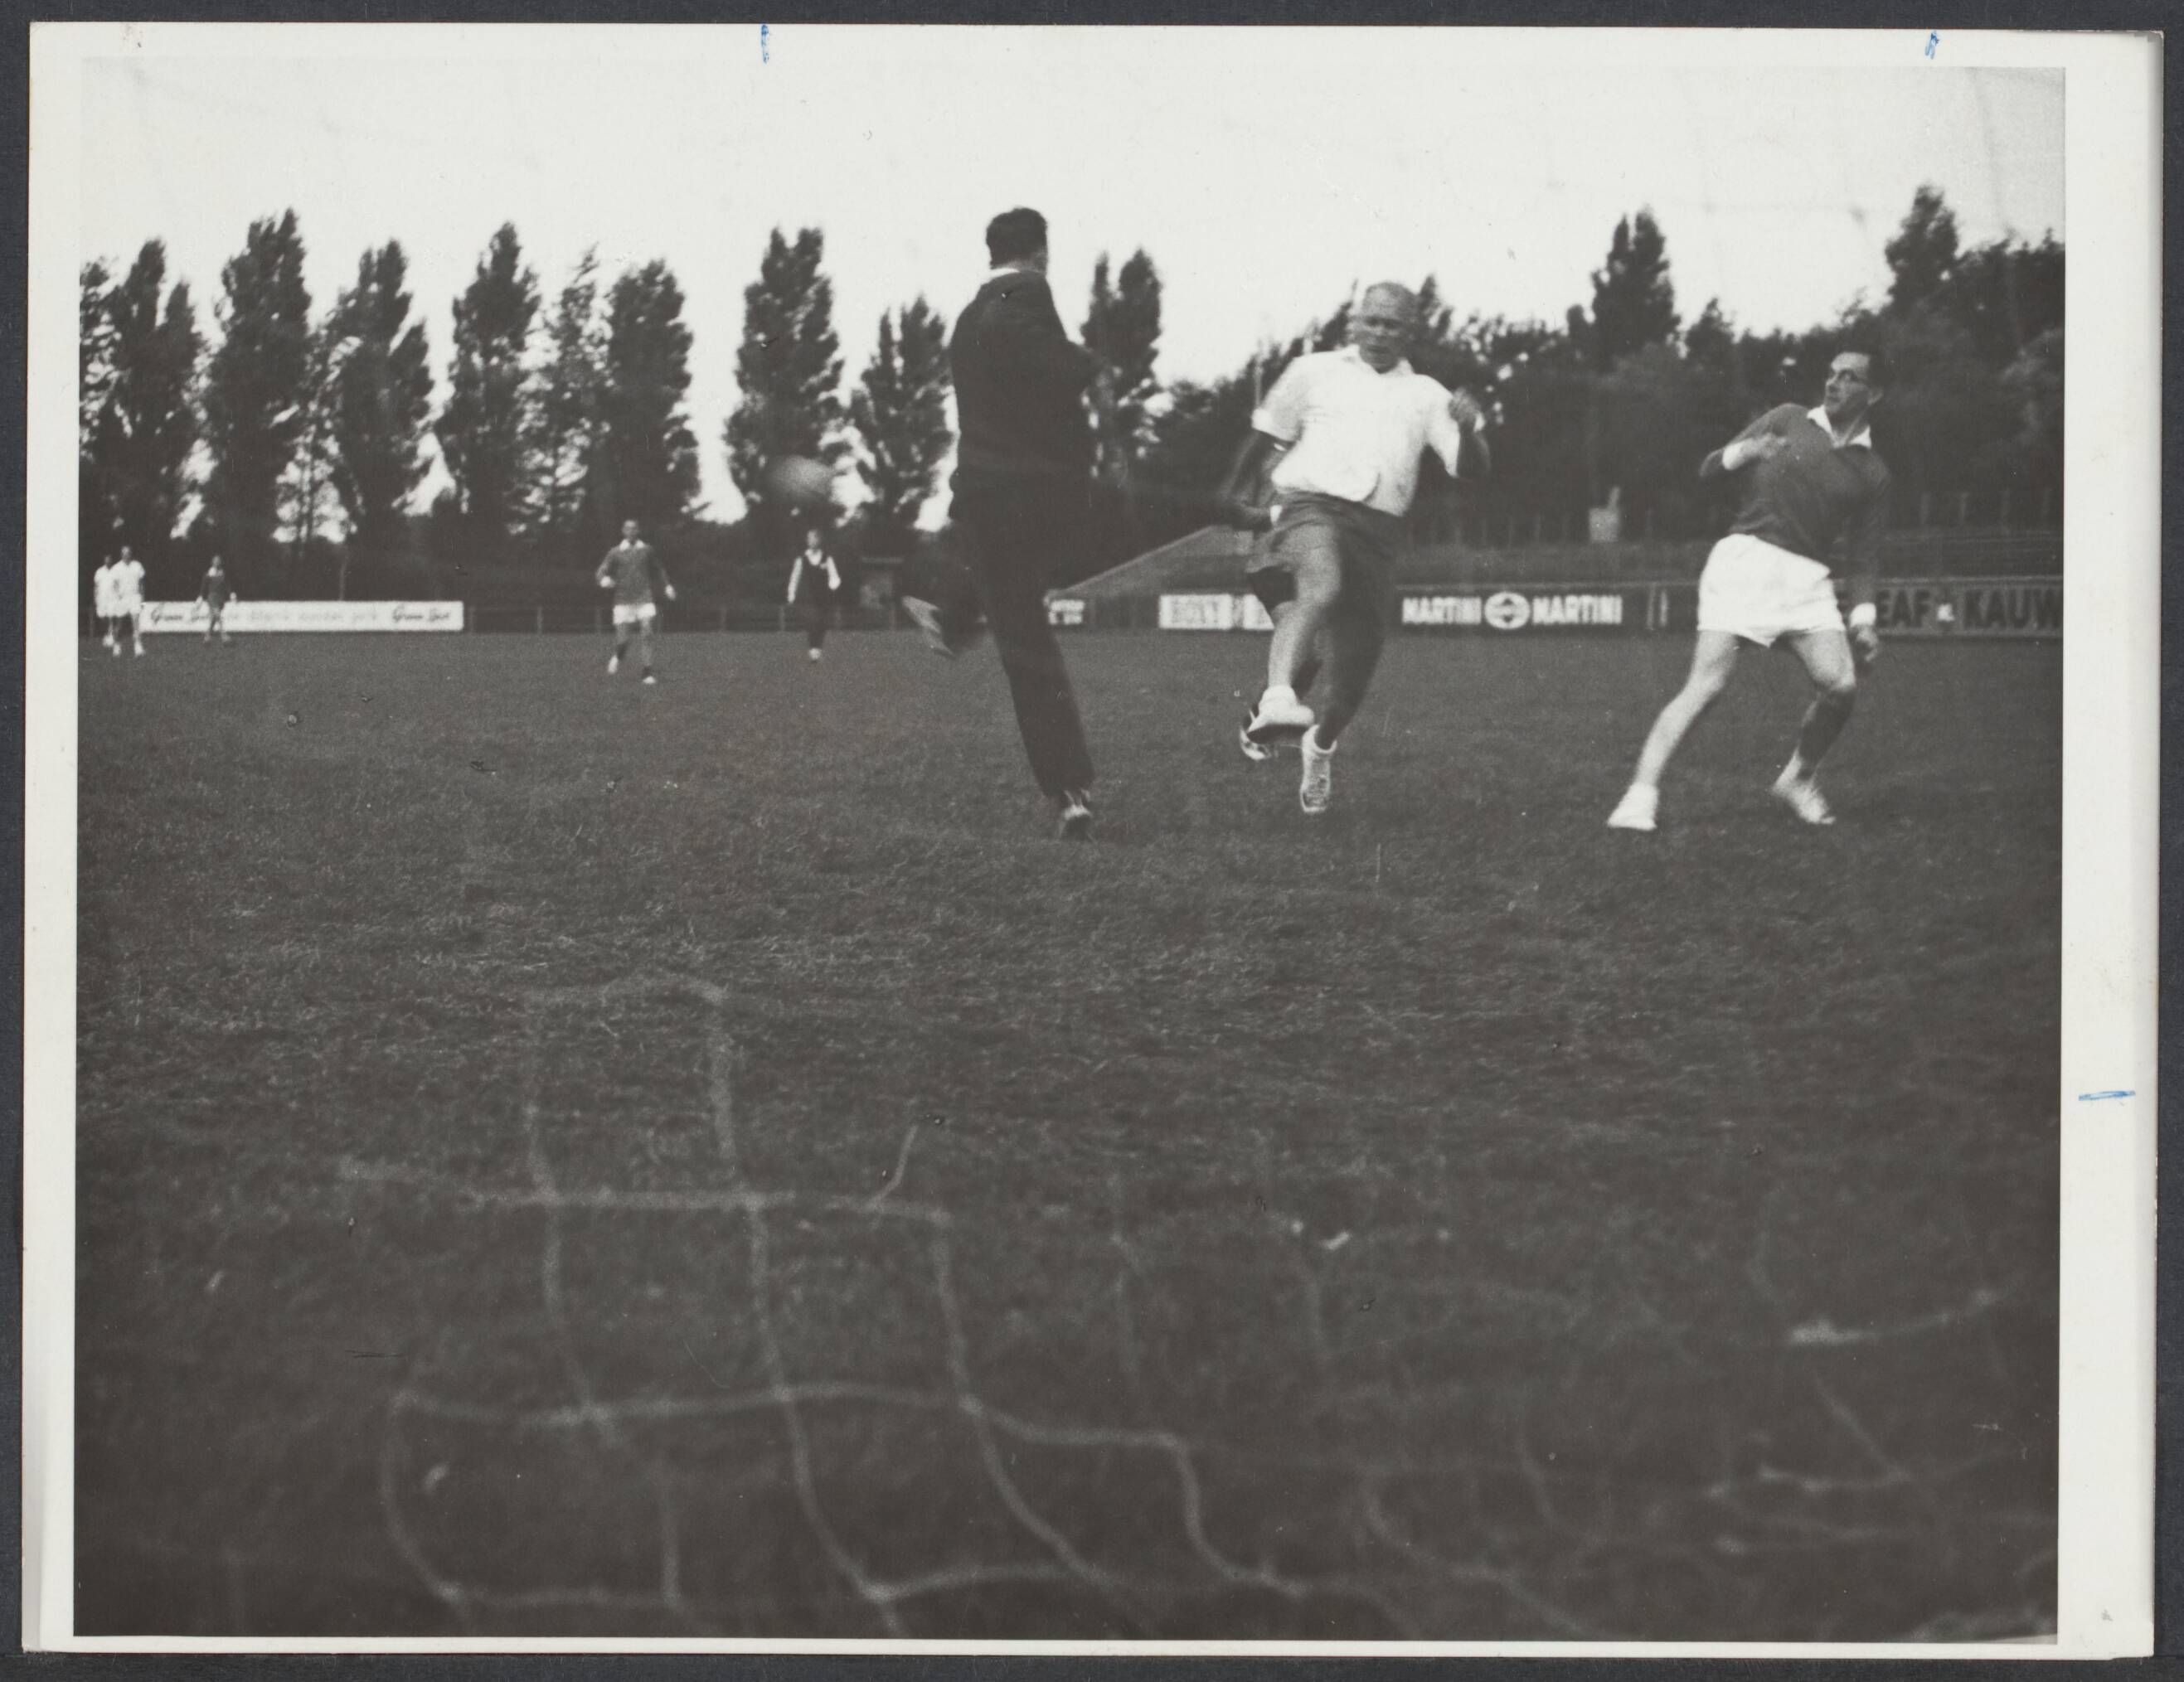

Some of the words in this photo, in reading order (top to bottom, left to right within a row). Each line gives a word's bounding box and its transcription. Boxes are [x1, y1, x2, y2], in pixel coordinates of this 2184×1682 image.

[1402, 597, 1482, 624] MARTINI
[1532, 594, 1623, 624] MARTINI
[1874, 589, 1932, 628] EAF
